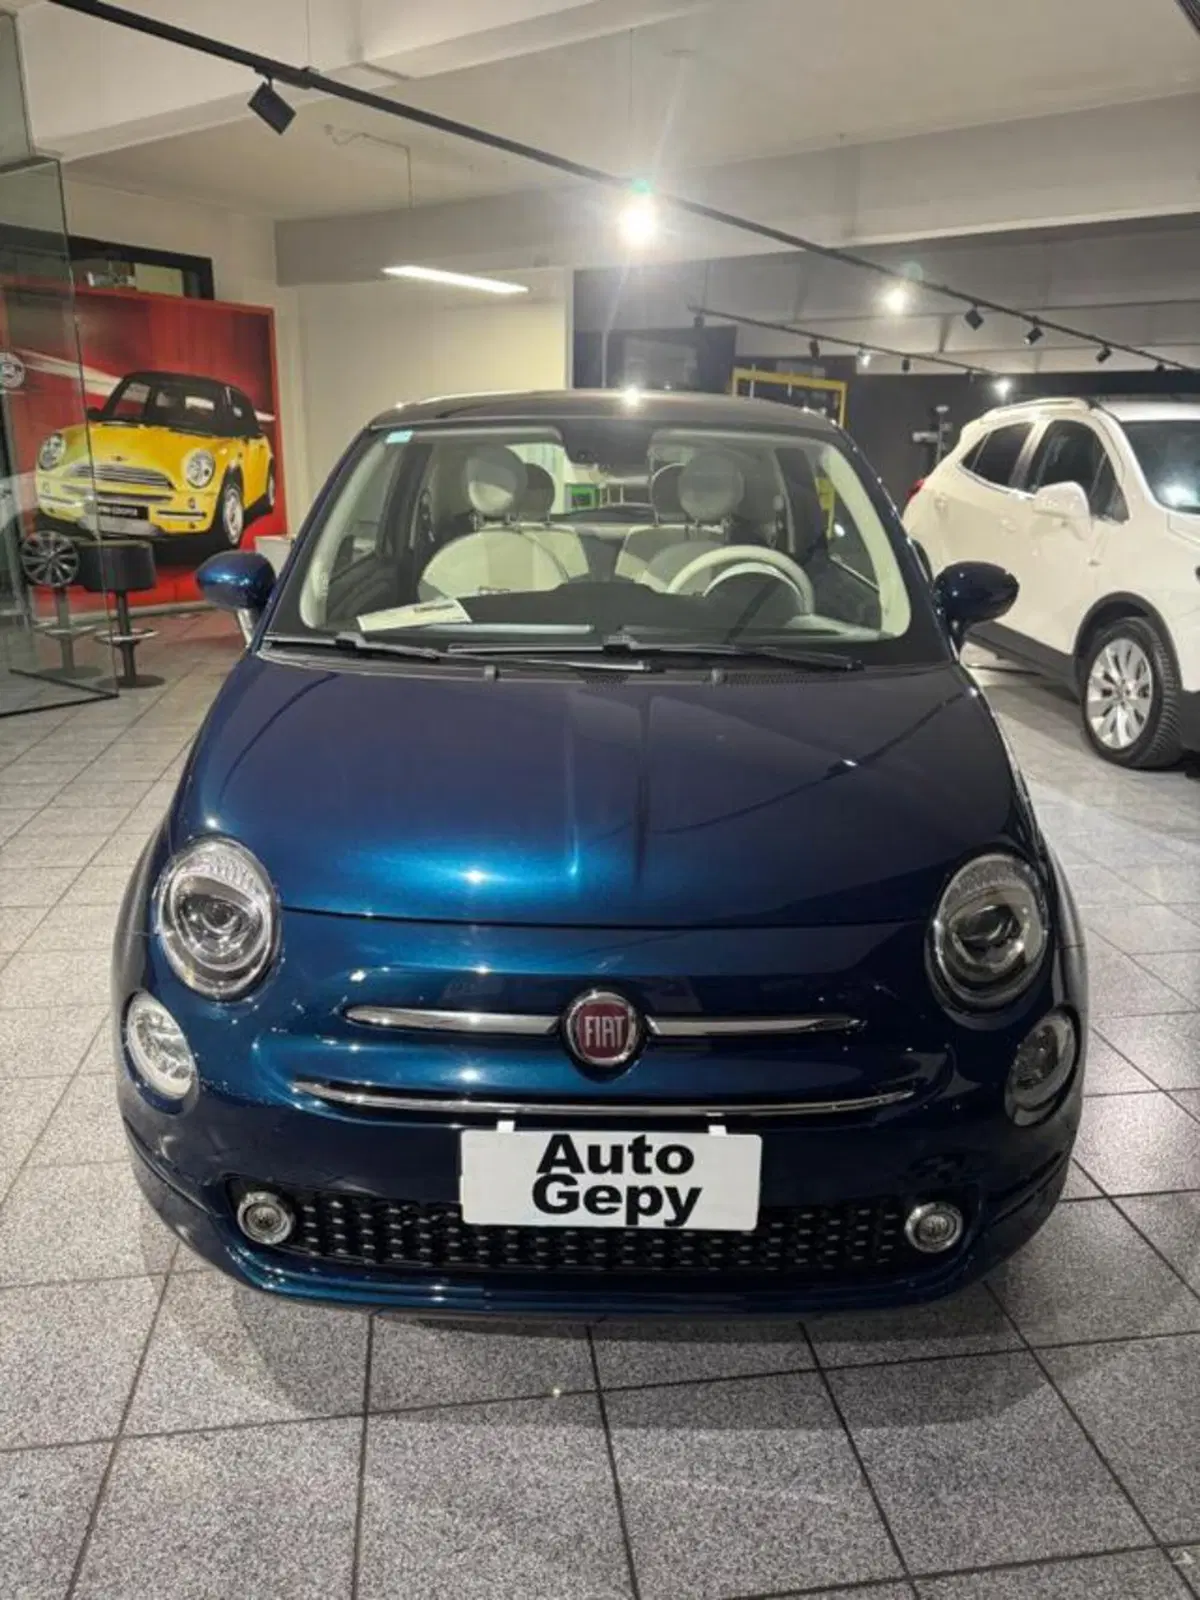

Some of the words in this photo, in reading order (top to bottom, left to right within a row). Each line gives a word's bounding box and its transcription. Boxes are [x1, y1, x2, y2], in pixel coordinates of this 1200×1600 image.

[583, 1015, 626, 1049] FIAT
[536, 1133, 695, 1175] Auto
[532, 1173, 702, 1229] Gepy
